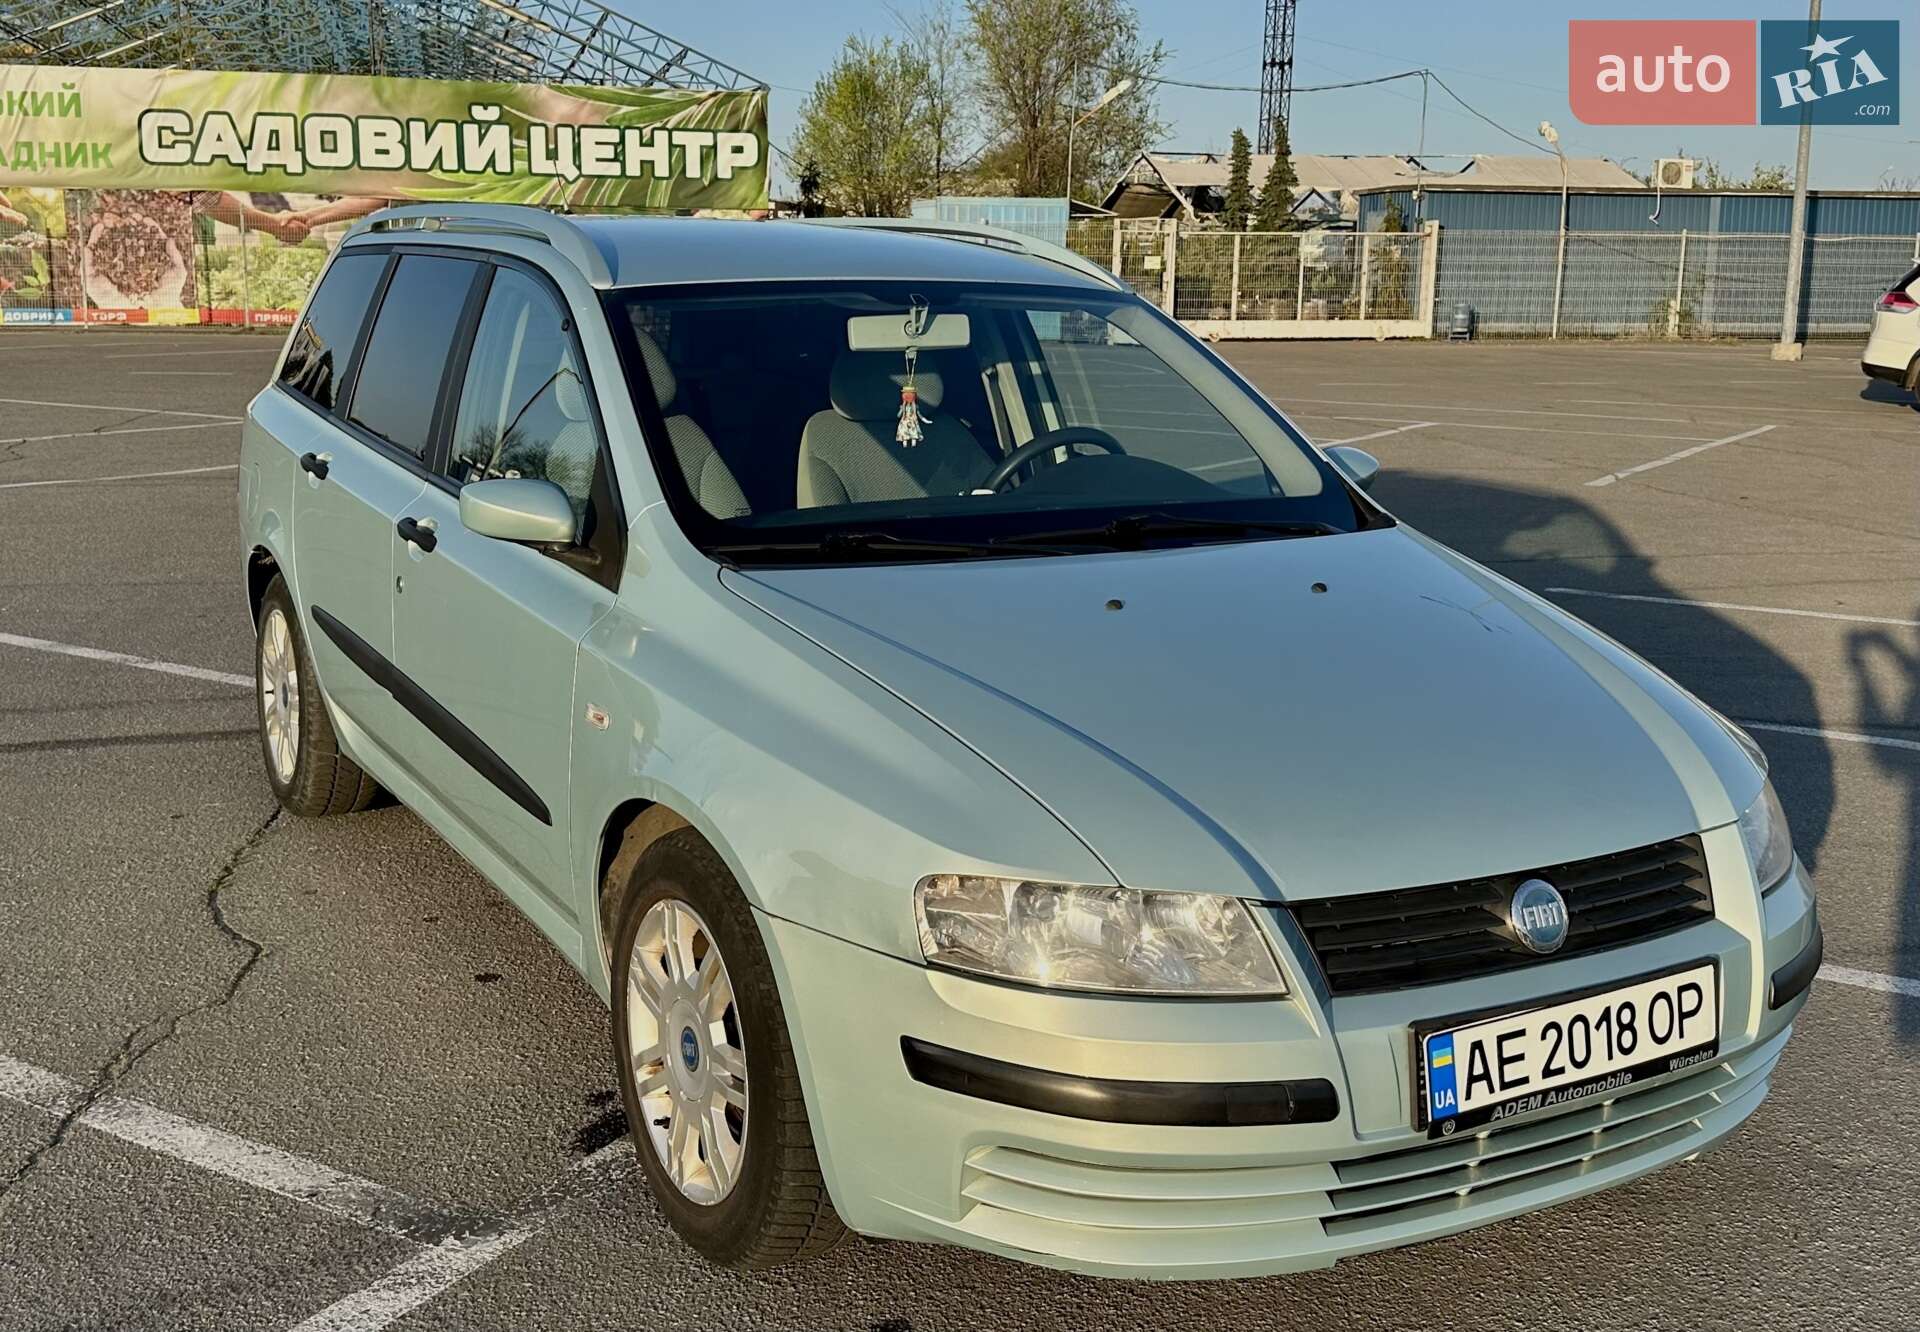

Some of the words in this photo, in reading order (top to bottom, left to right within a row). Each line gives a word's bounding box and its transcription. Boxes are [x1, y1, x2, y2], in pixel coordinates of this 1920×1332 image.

[138, 103, 513, 175] САДОВИЙ
[527, 124, 760, 183] ЦЕНТР
[1522, 901, 1561, 930] FIAT
[1465, 1028, 1530, 1101] AE
[1540, 1001, 1638, 1080] 2018
[1648, 982, 1703, 1045] OP
[1435, 1088, 1456, 1108] UA
[1490, 1094, 1543, 1121] ADEM
[1545, 1072, 1633, 1106] Automobile
